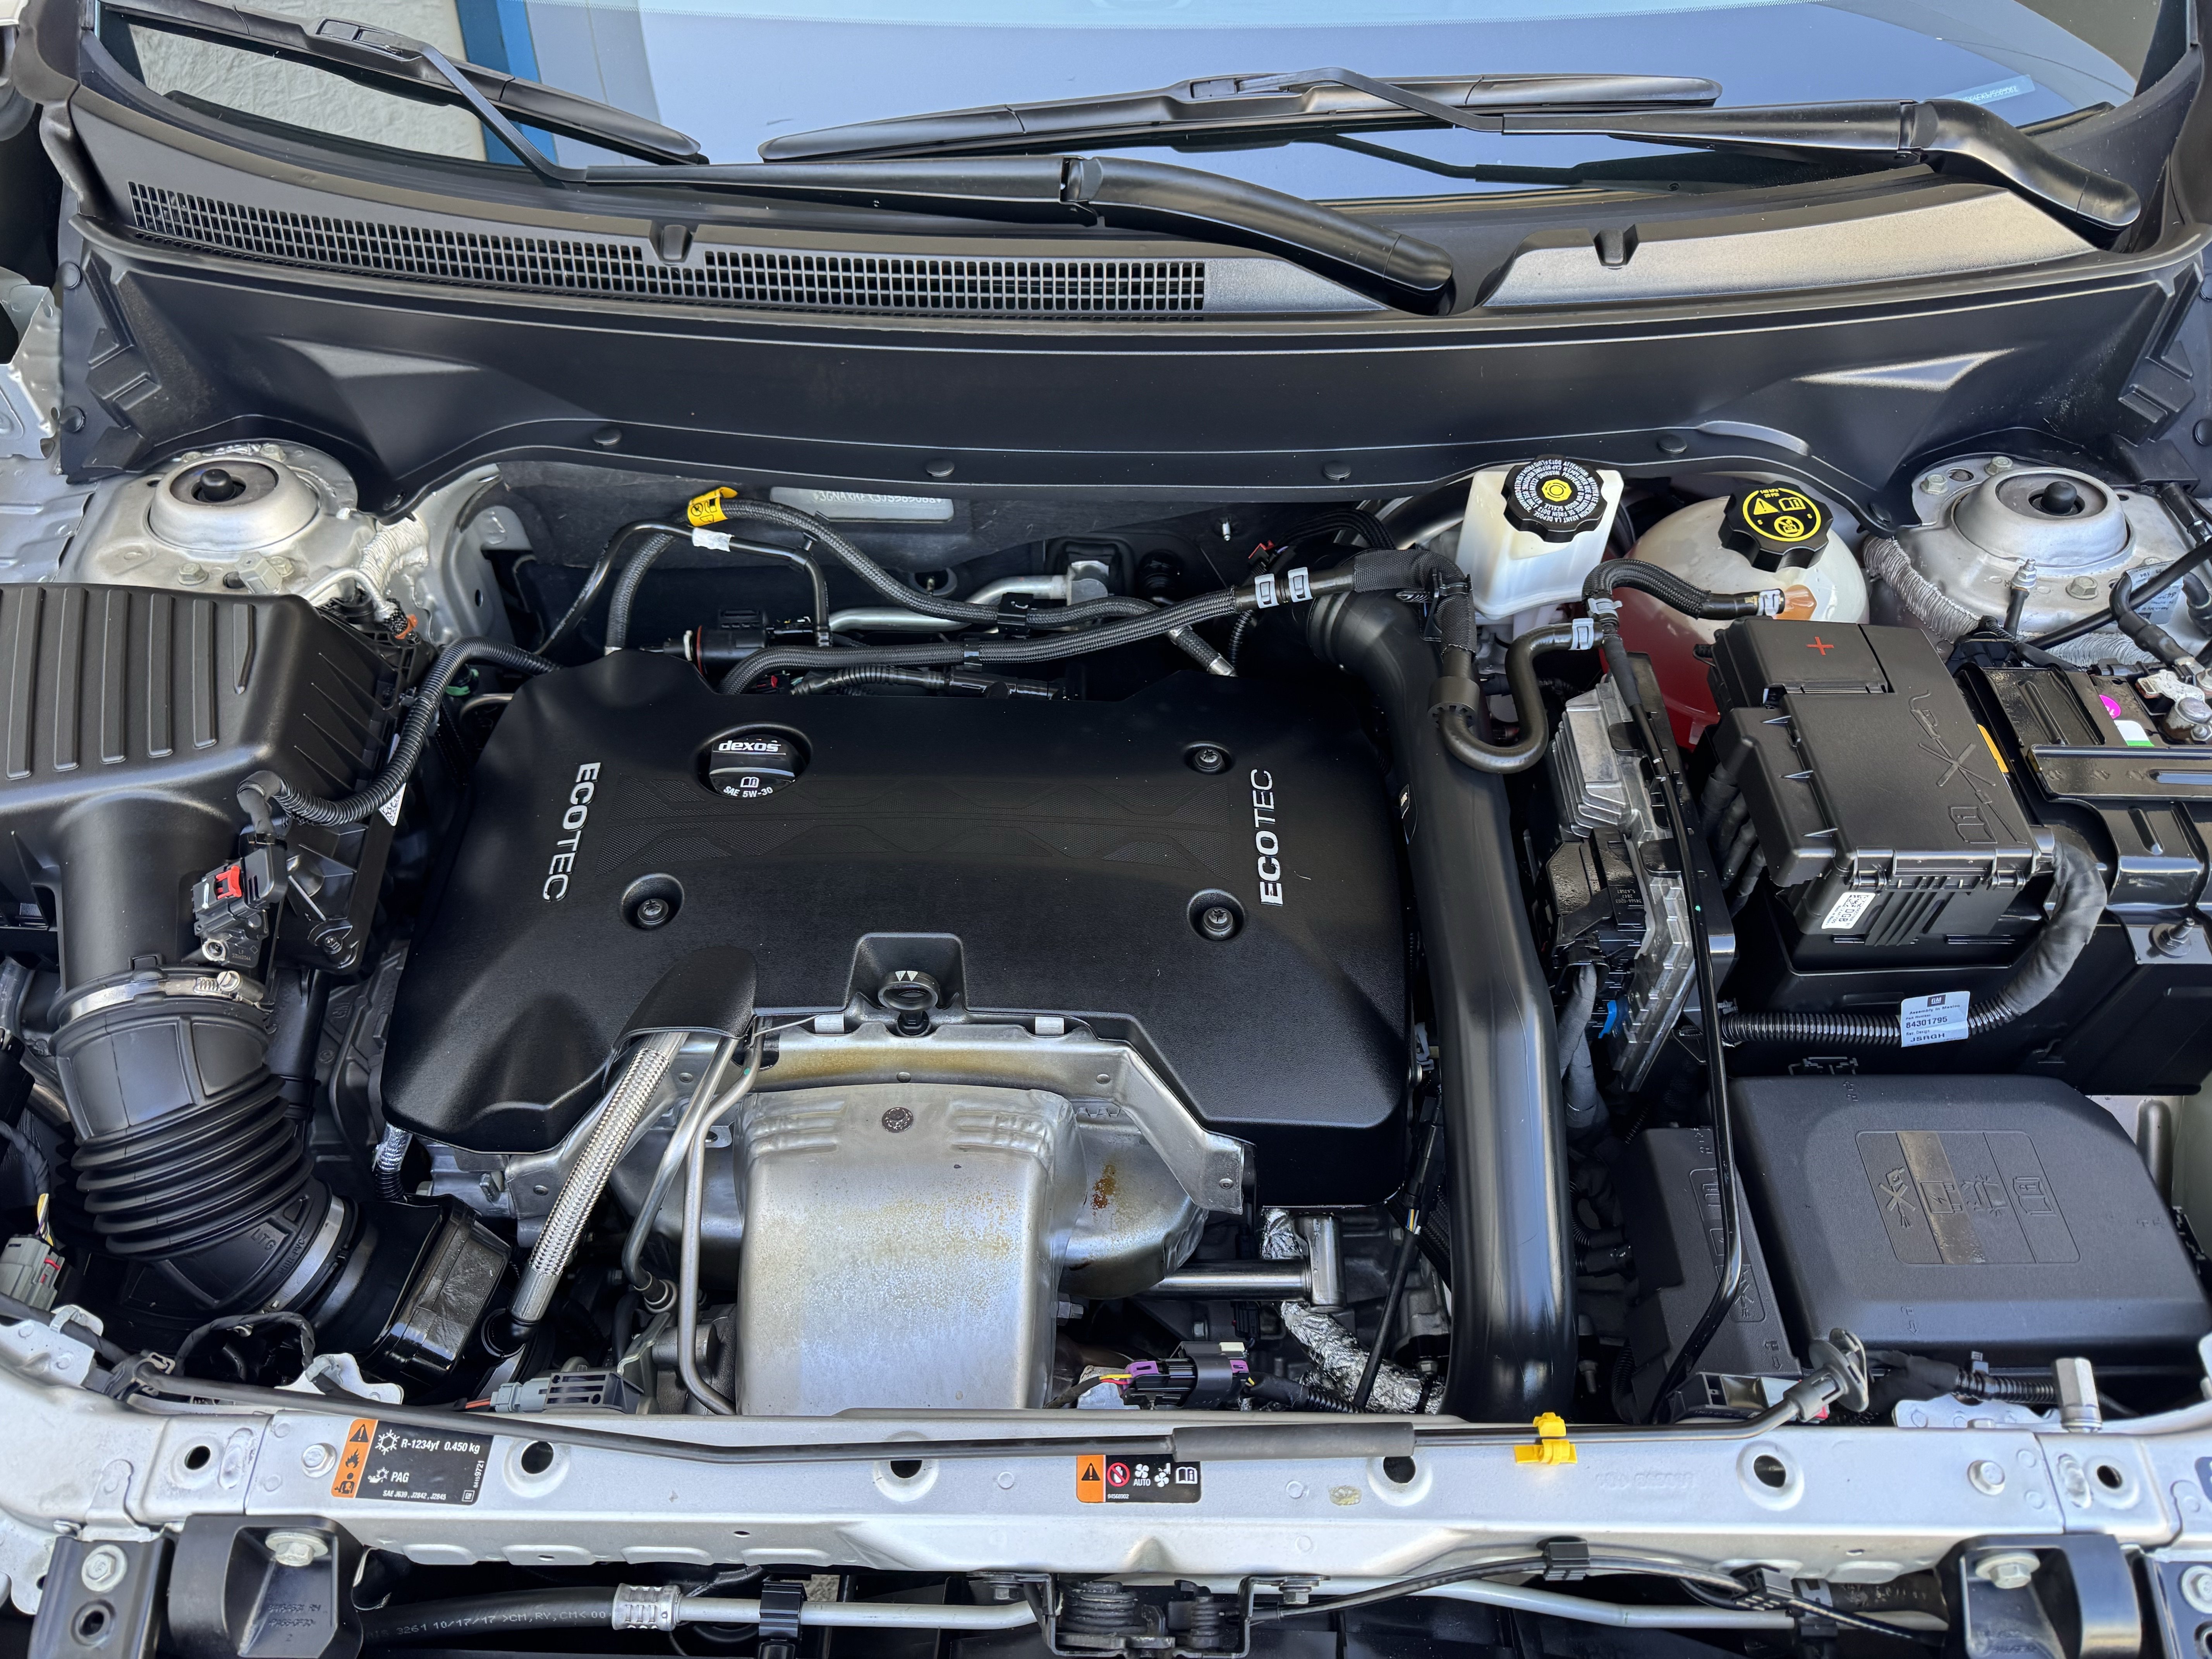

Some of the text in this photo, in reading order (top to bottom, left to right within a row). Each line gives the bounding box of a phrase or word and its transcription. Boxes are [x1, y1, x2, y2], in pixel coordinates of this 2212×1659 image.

[719, 740, 779, 752] dexos
[723, 786, 773, 797] SAE 5W-30
[543, 762, 601, 902] ECOTEC
[1250, 769, 1283, 906] ECOTEC
[1837, 909, 1855, 922] DGB
[1906, 1016, 1948, 1029] 84301795
[251, 1228, 276, 1250] LTG
[400, 1439, 480, 1454] R-1234yf 0.450 kg
[390, 1471, 410, 1483] PAG
[433, 1616, 495, 1630] 10/17/17
